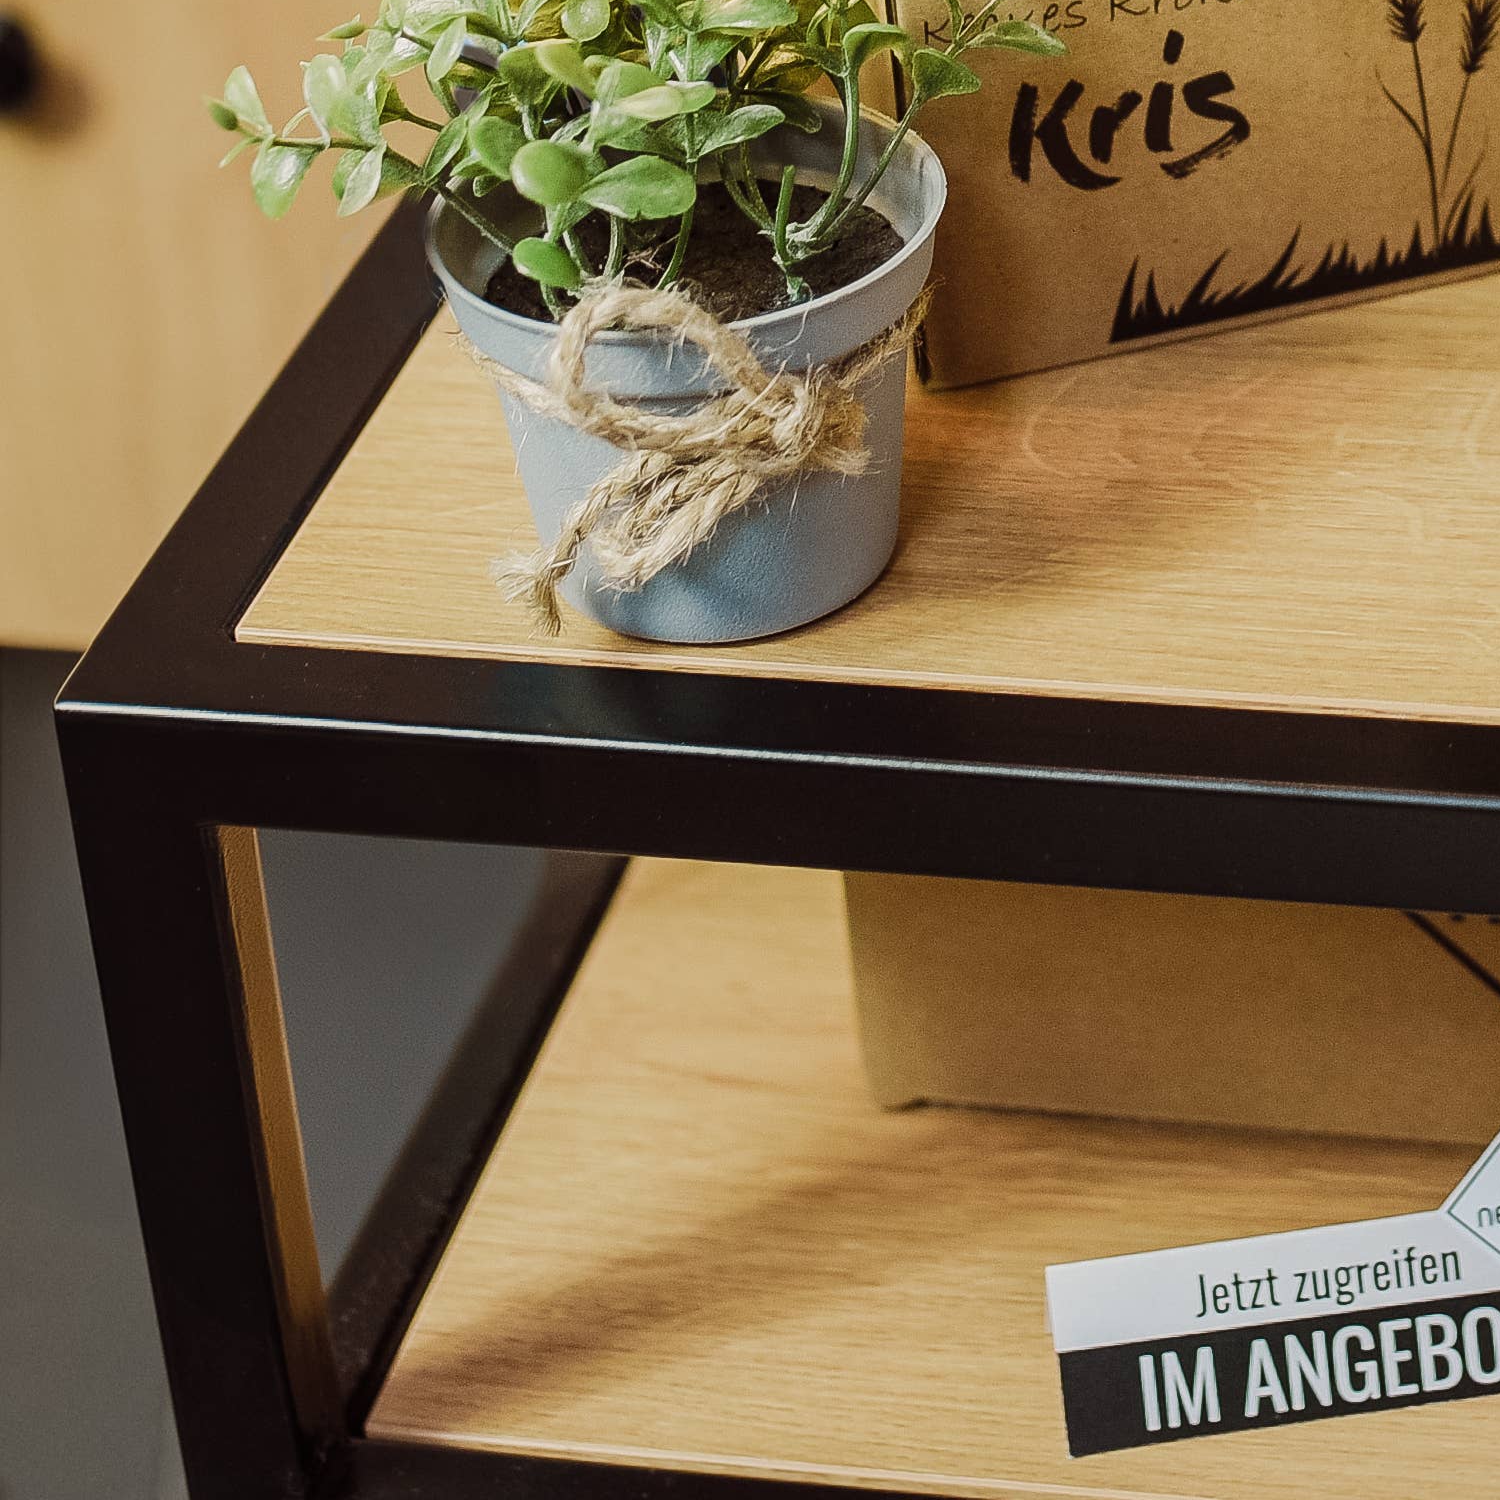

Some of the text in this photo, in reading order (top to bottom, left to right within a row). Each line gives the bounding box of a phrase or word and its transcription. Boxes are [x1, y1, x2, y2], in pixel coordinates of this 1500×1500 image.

[1008, 28, 1252, 191] Kris
[1196, 1246, 1462, 1318] Jetzt zugreifen
[1137, 1345, 1222, 1432] IM
